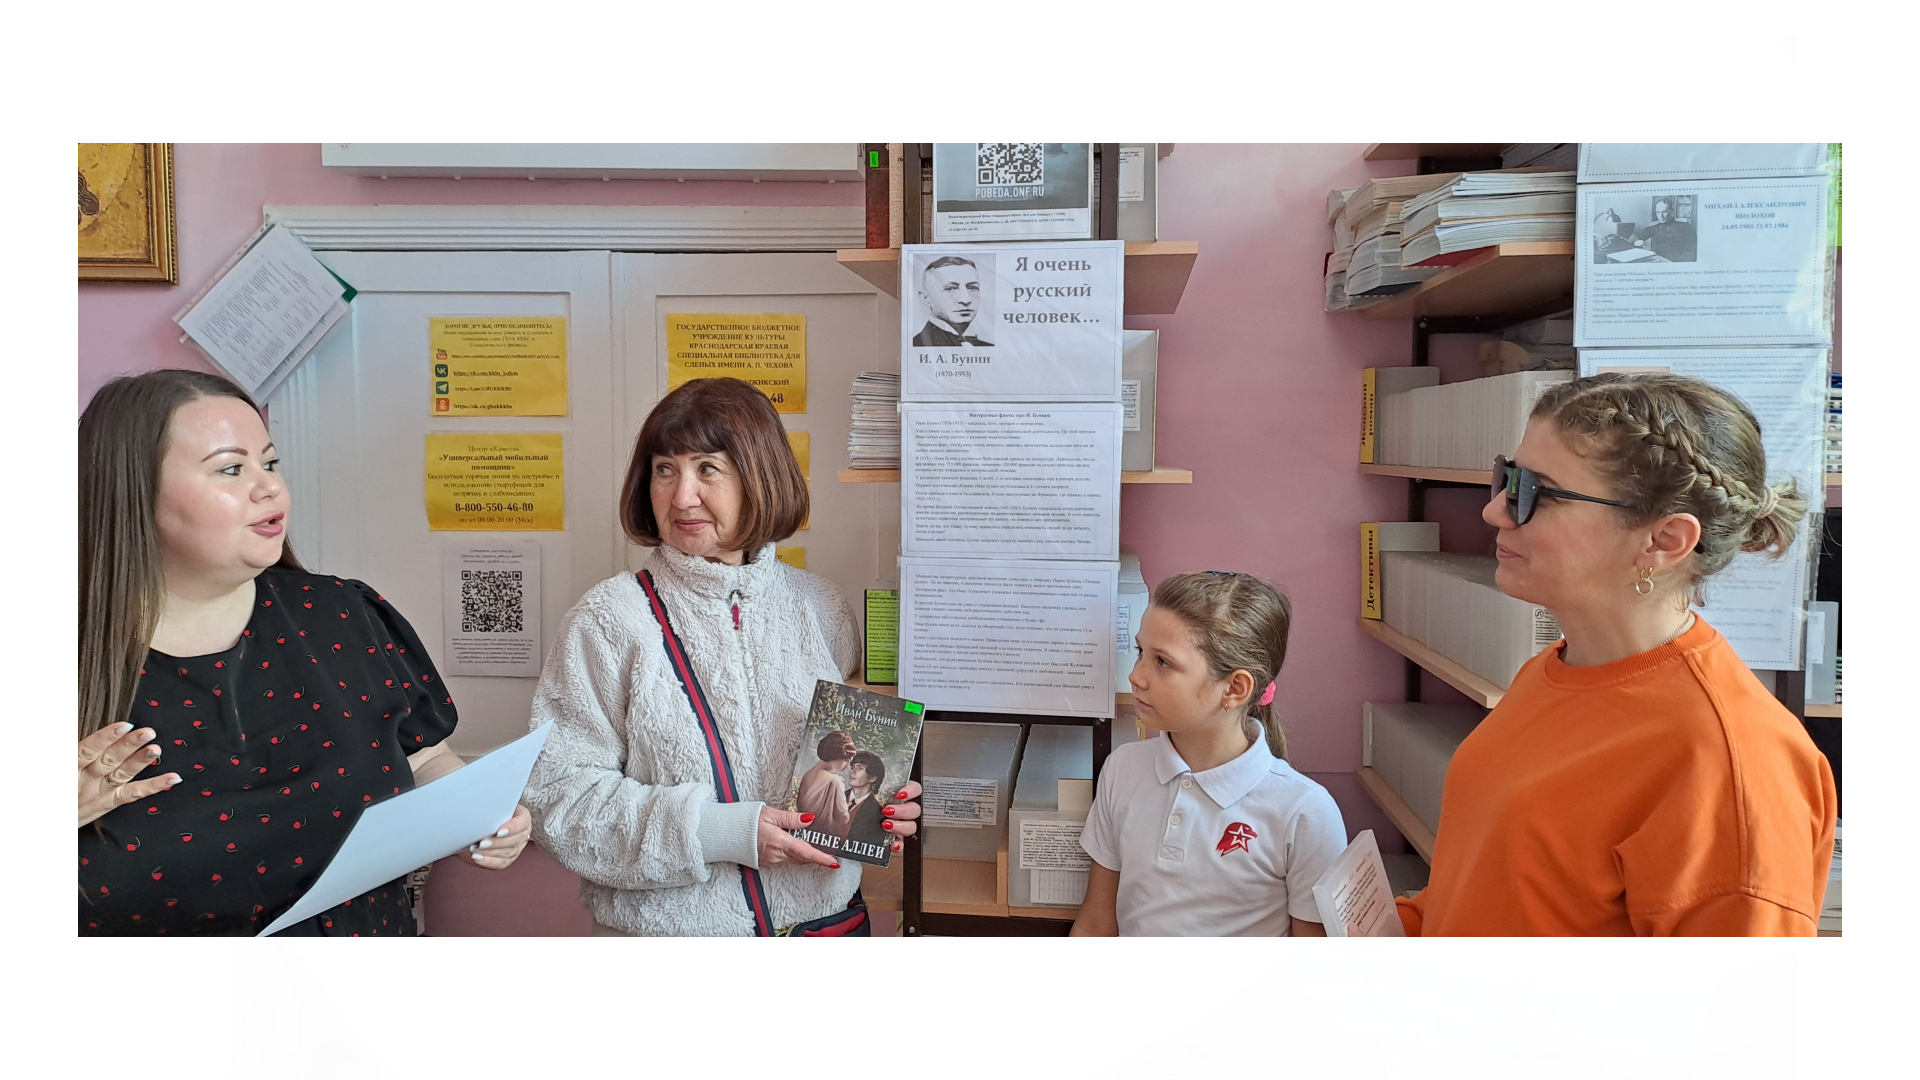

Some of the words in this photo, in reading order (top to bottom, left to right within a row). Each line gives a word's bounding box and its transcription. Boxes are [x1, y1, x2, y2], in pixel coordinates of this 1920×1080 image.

[975, 186, 1044, 198] POBEDA.ONF.RU
[1015, 257, 1028, 271] Я
[1034, 259, 1091, 271] очень
[1013, 284, 1091, 302] русский
[676, 324, 750, 332] ГОСУДАРСТВЕННОЕ
[919, 354, 932, 364] И.
[935, 354, 948, 364] А.
[951, 354, 990, 365] Бунин
[935, 370, 972, 378] (1870-1953)
[439, 454, 503, 462] «Универсальный
[455, 502, 534, 512] 8-800-550-46-80
[1367, 530, 1375, 610] Детективы
[835, 702, 862, 719] Иван
[865, 709, 898, 728] Бунин
[841, 839, 885, 859] АЛЛЕИ
